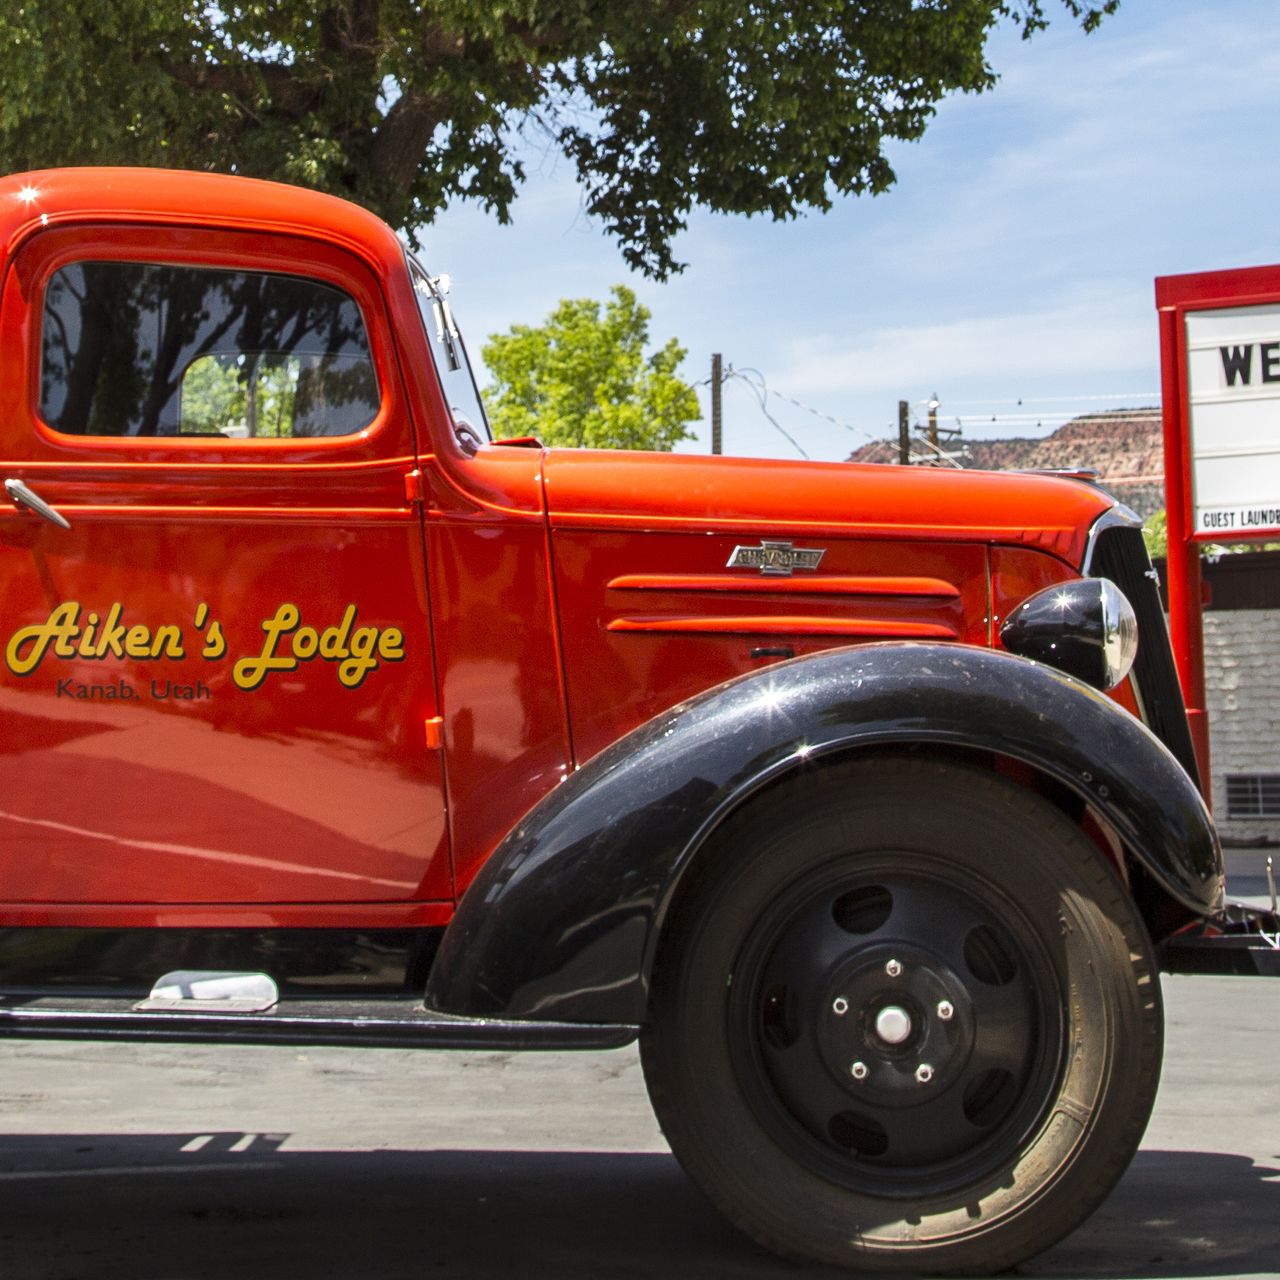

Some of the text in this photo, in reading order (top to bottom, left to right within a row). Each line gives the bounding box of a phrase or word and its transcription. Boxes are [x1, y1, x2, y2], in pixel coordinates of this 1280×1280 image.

[1203, 511, 1235, 528] GUEST
[736, 549, 821, 568] CHEVROLET
[5, 600, 407, 691] Aiken's Lodge
[55, 677, 212, 703] Kanab, Utah
